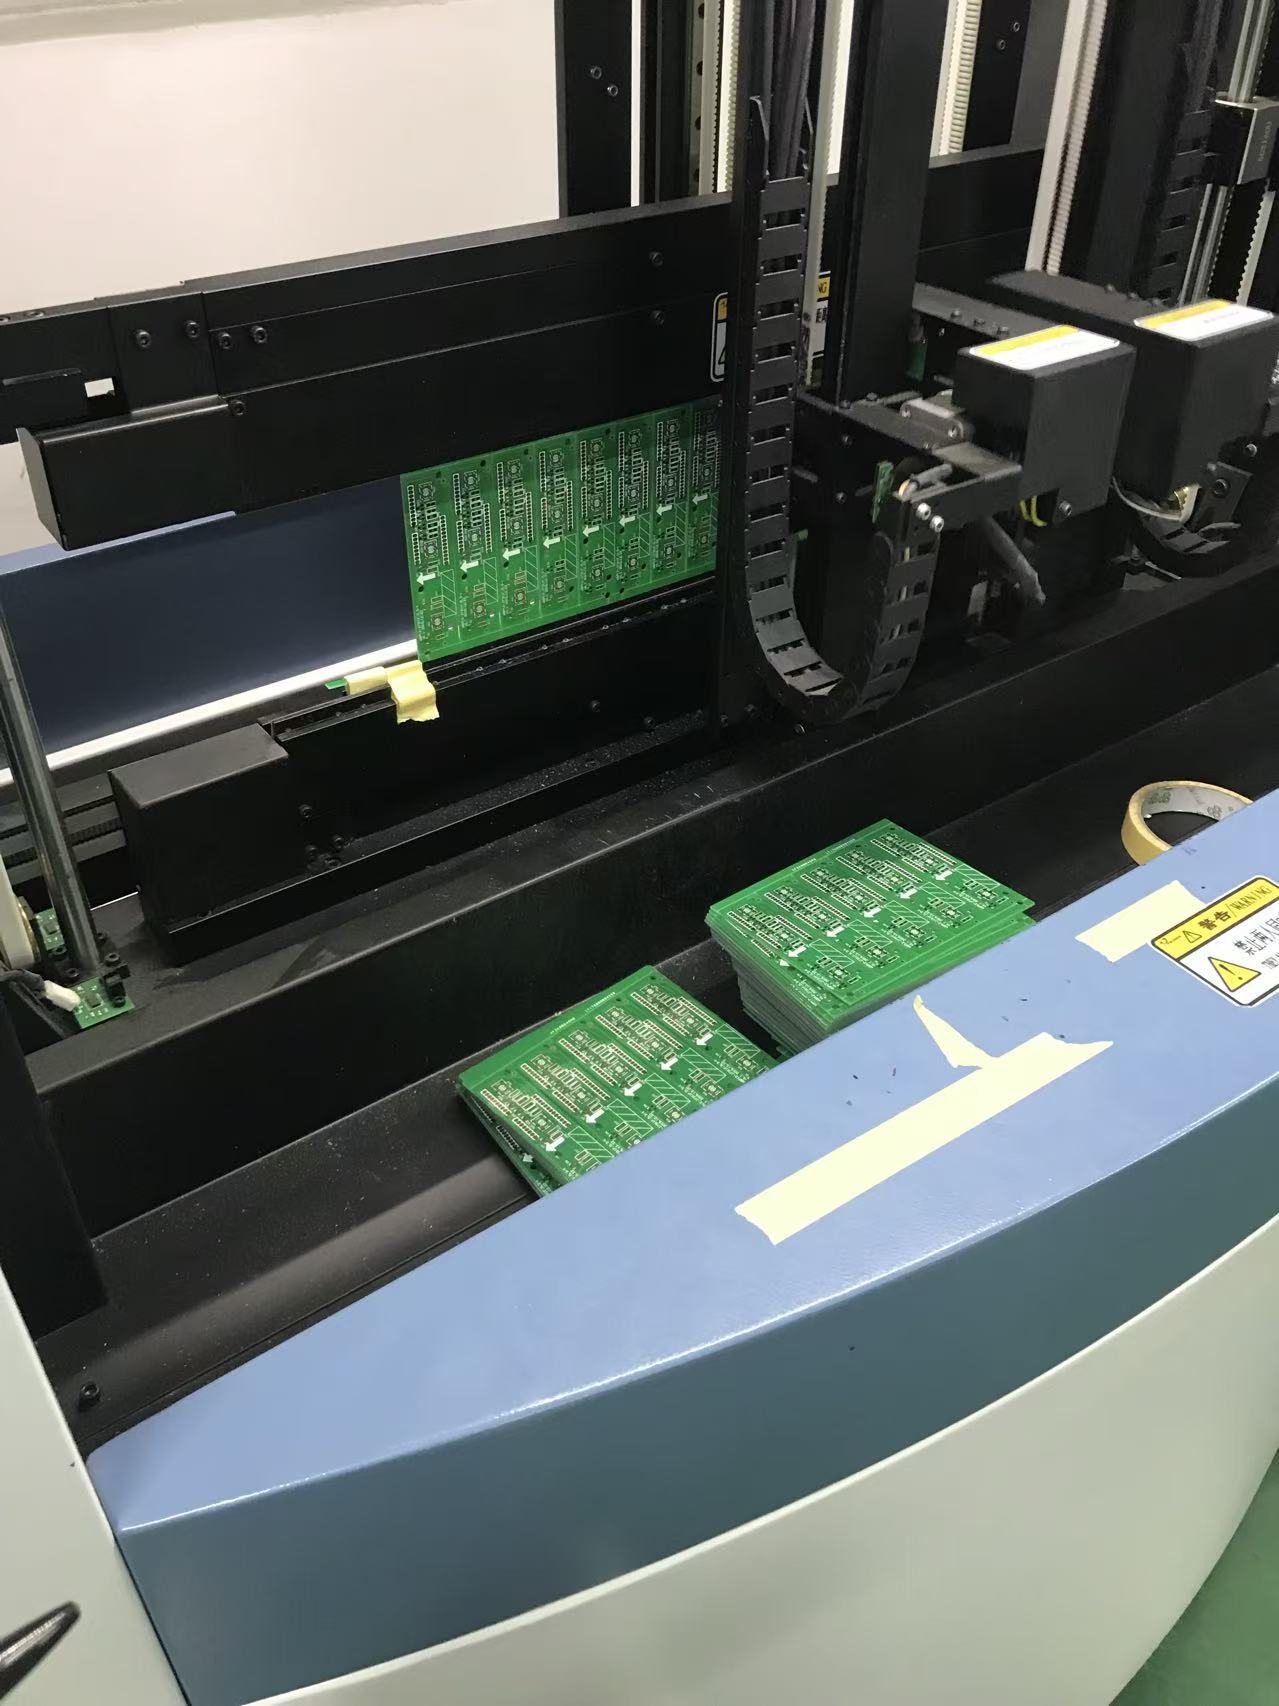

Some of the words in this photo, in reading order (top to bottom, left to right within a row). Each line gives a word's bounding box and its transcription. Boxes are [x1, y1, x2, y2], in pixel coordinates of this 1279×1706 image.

[1233, 917, 1279, 956] 禁止两人同
